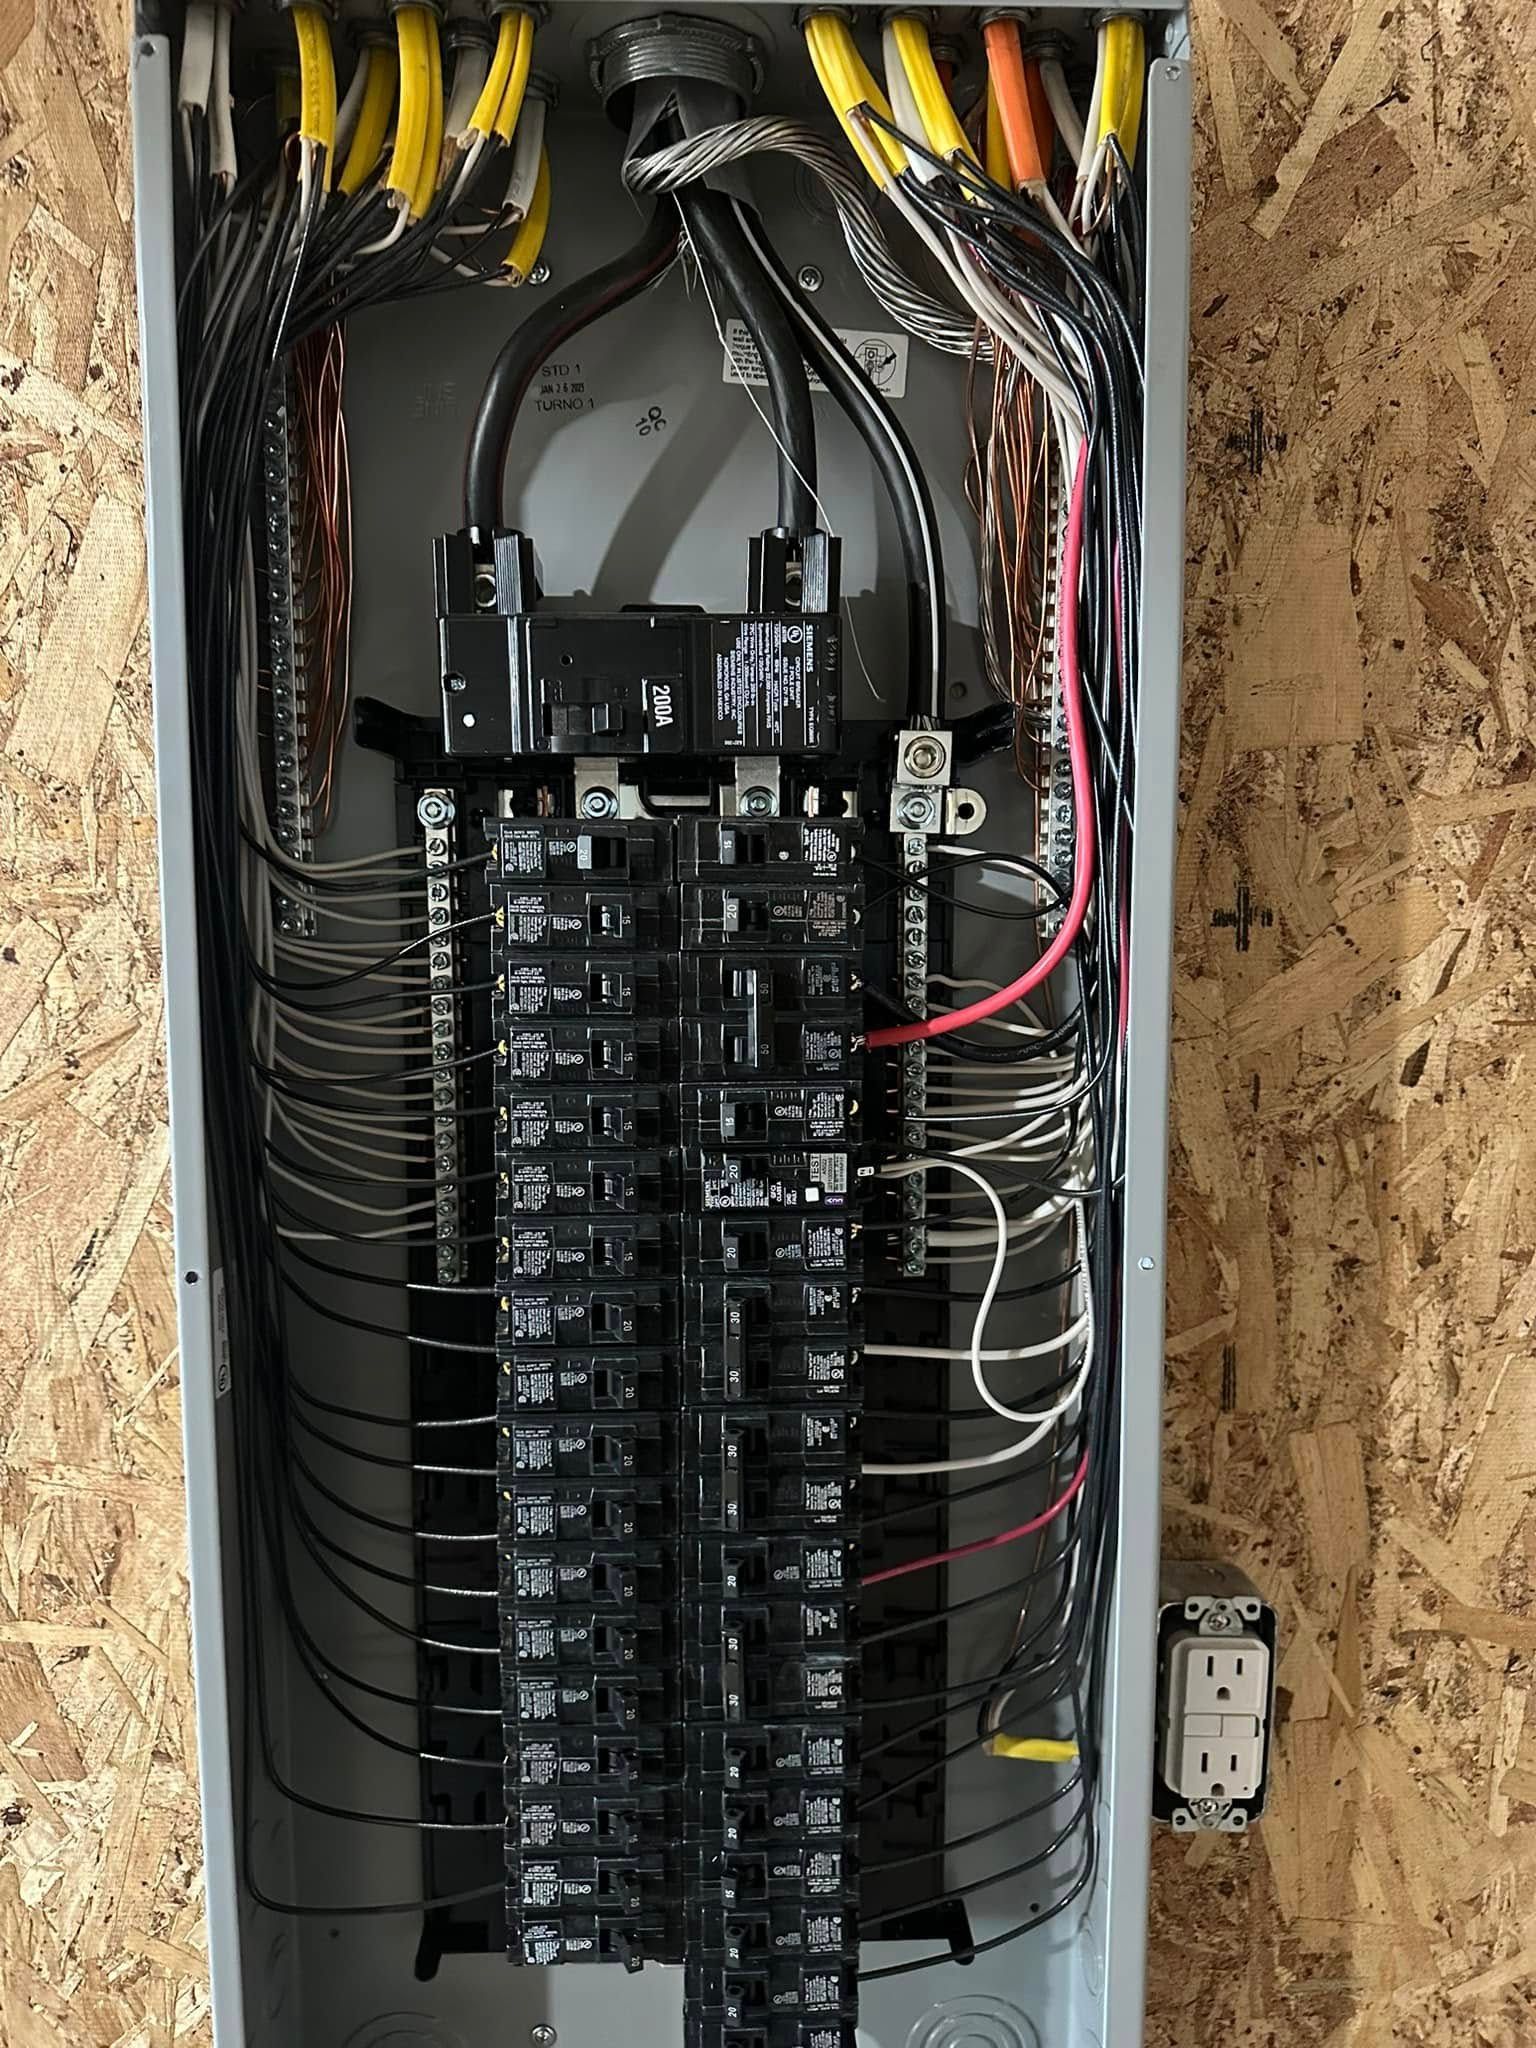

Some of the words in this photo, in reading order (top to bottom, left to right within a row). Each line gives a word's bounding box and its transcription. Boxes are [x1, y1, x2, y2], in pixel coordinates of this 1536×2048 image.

[542, 365, 570, 377] STD
[575, 364, 581, 375] 1
[536, 399, 584, 412] TURNO
[589, 398, 594, 409] 1
[648, 406, 667, 432] QC
[652, 684, 673, 727] 200A
[727, 904, 737, 919] 20
[622, 915, 631, 925] 15
[622, 987, 631, 997] 15
[624, 1052, 633, 1061] 15
[623, 1120, 633, 1130] 15
[729, 1165, 738, 1179] 20
[624, 1252, 633, 1262] 15
[727, 1247, 737, 1260] 20
[731, 1311, 740, 1324] 30
[623, 1320, 632, 1331] 20
[730, 1370, 740, 1383] 30
[624, 1387, 634, 1399] 20
[728, 1445, 737, 1457] 30
[623, 1454, 633, 1466] 20
[727, 1503, 737, 1515] 30
[624, 1522, 633, 1534] 20
[727, 1575, 737, 1587] 20
[624, 1585, 633, 1597] 20
[729, 1638, 738, 1650] 30
[624, 1649, 633, 1660] 20
[729, 1694, 738, 1707] 30
[626, 1708, 635, 1720] 20
[730, 1767, 740, 1779] 20
[728, 1828, 737, 1840] 20
[725, 1889, 734, 1899] 15
[630, 1896, 639, 1908] 20
[730, 1948, 739, 1959] 20
[630, 1956, 639, 1967] 20
[727, 2007, 737, 2018] 20
